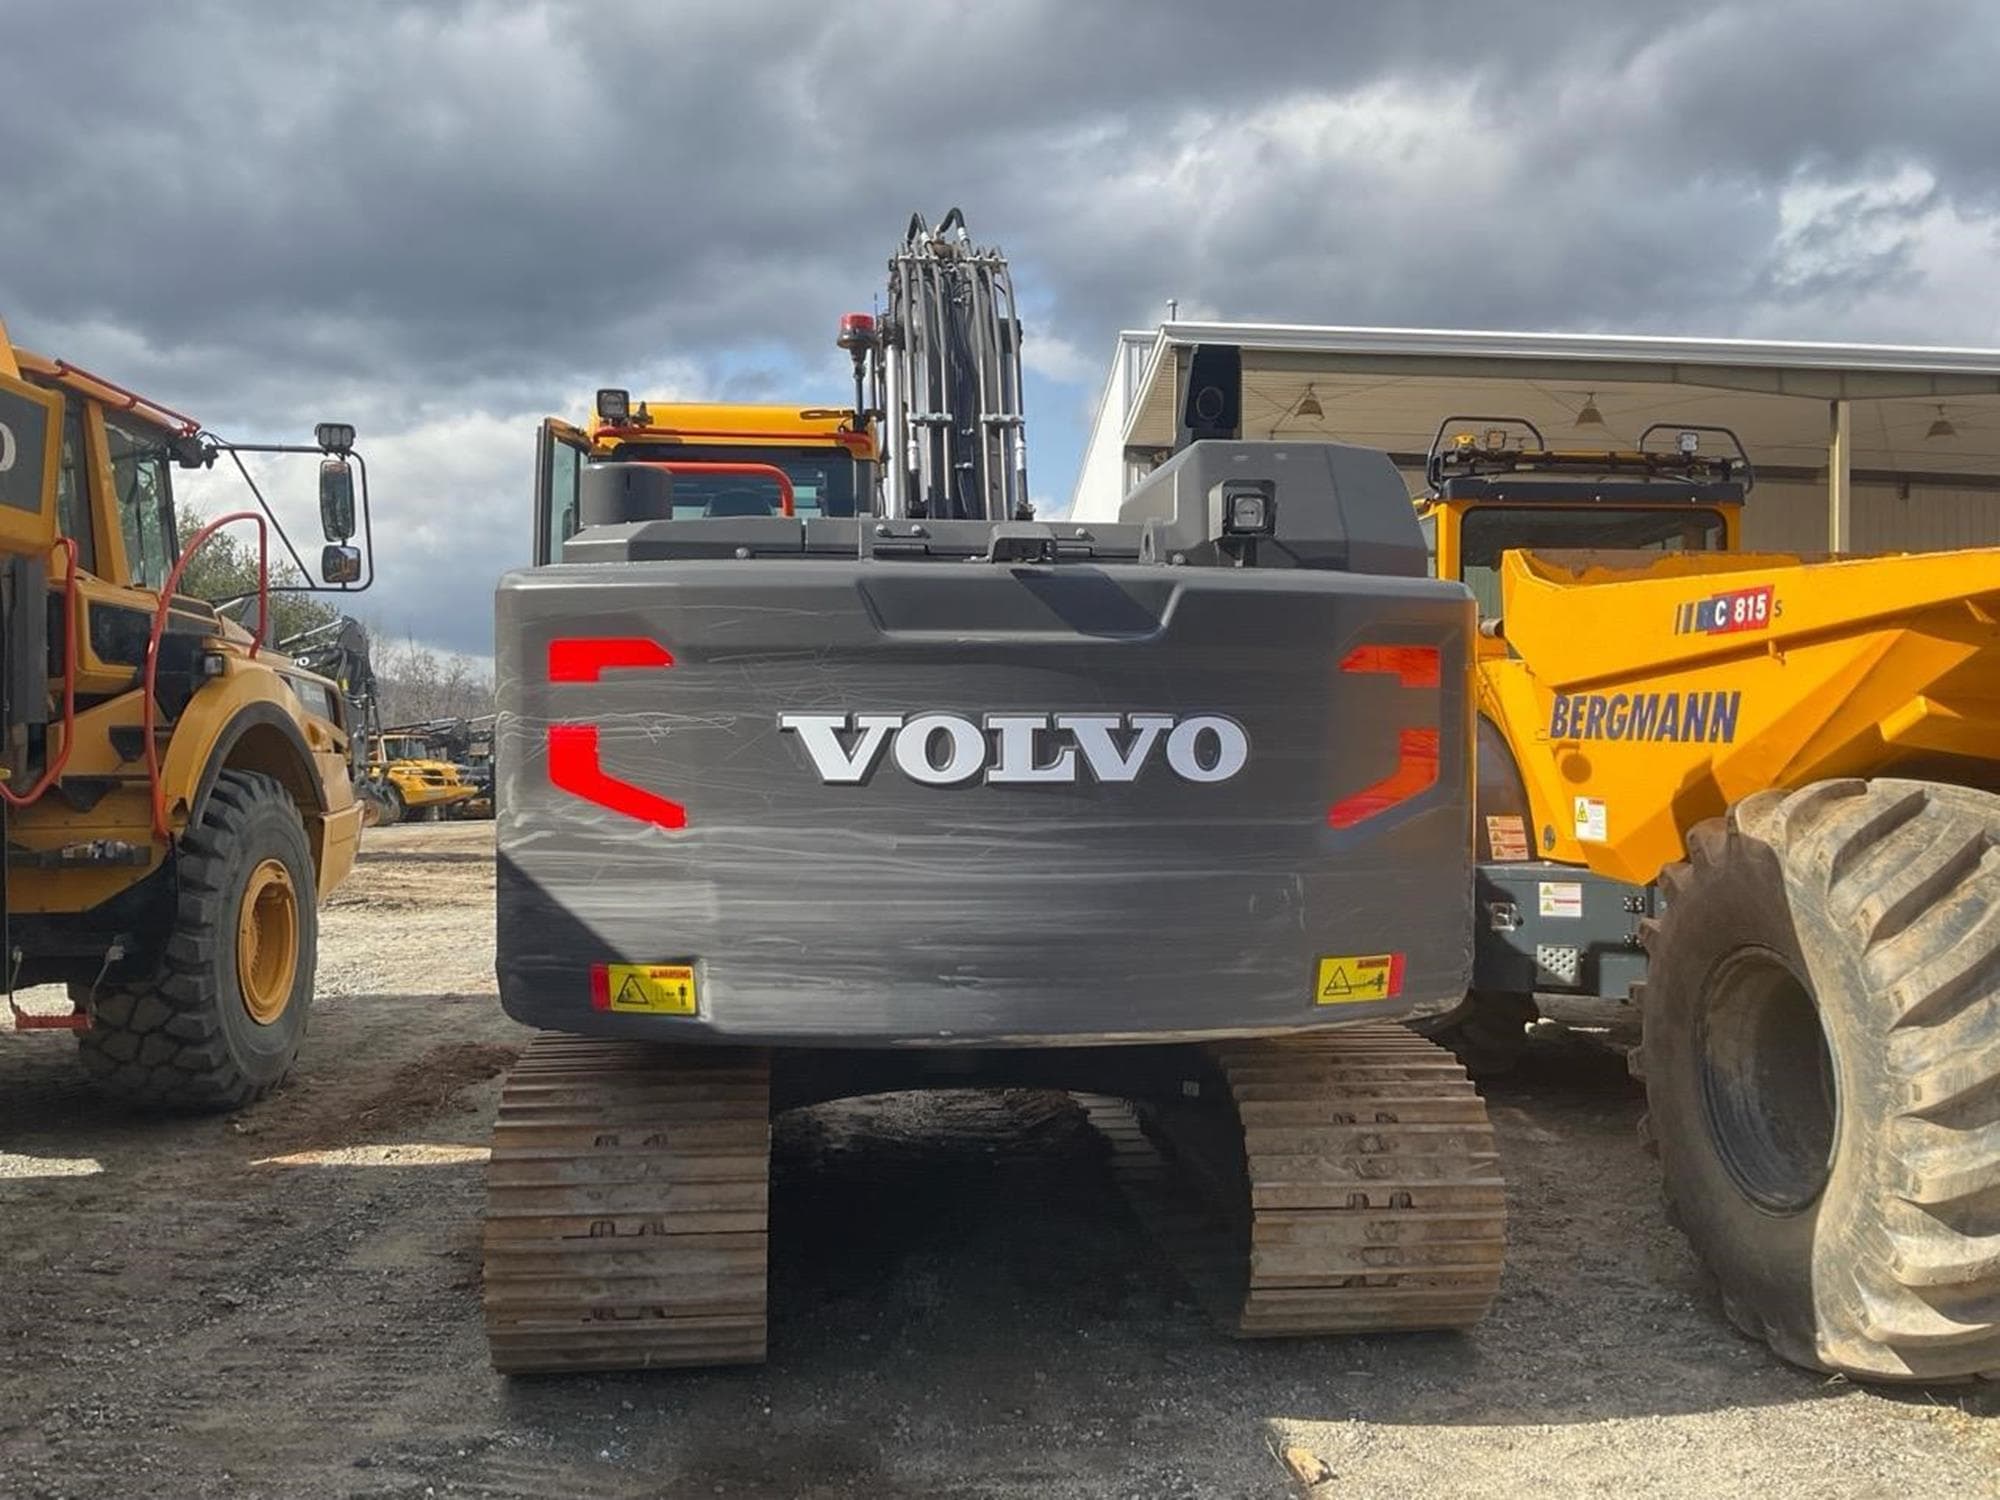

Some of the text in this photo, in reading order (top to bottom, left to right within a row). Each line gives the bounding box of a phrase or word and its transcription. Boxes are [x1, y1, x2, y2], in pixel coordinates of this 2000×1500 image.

[1714, 600, 1727, 626] C
[1734, 593, 1767, 623] 815
[1550, 691, 1741, 743] BERGMANN
[778, 712, 1249, 784] VOLVO
